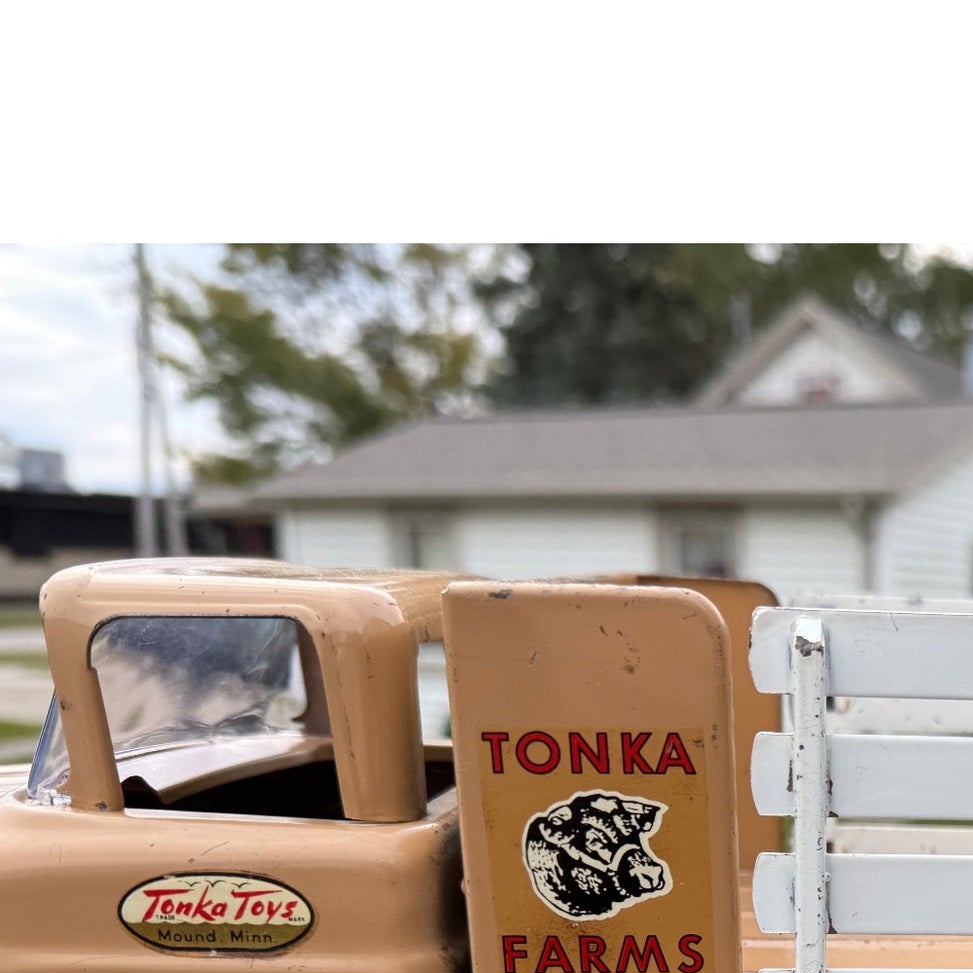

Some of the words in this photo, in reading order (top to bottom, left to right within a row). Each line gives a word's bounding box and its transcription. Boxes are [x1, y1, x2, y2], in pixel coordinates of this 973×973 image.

[481, 731, 697, 775] TONKA
[143, 885, 227, 921] Tonka
[231, 889, 298, 923] Toys
